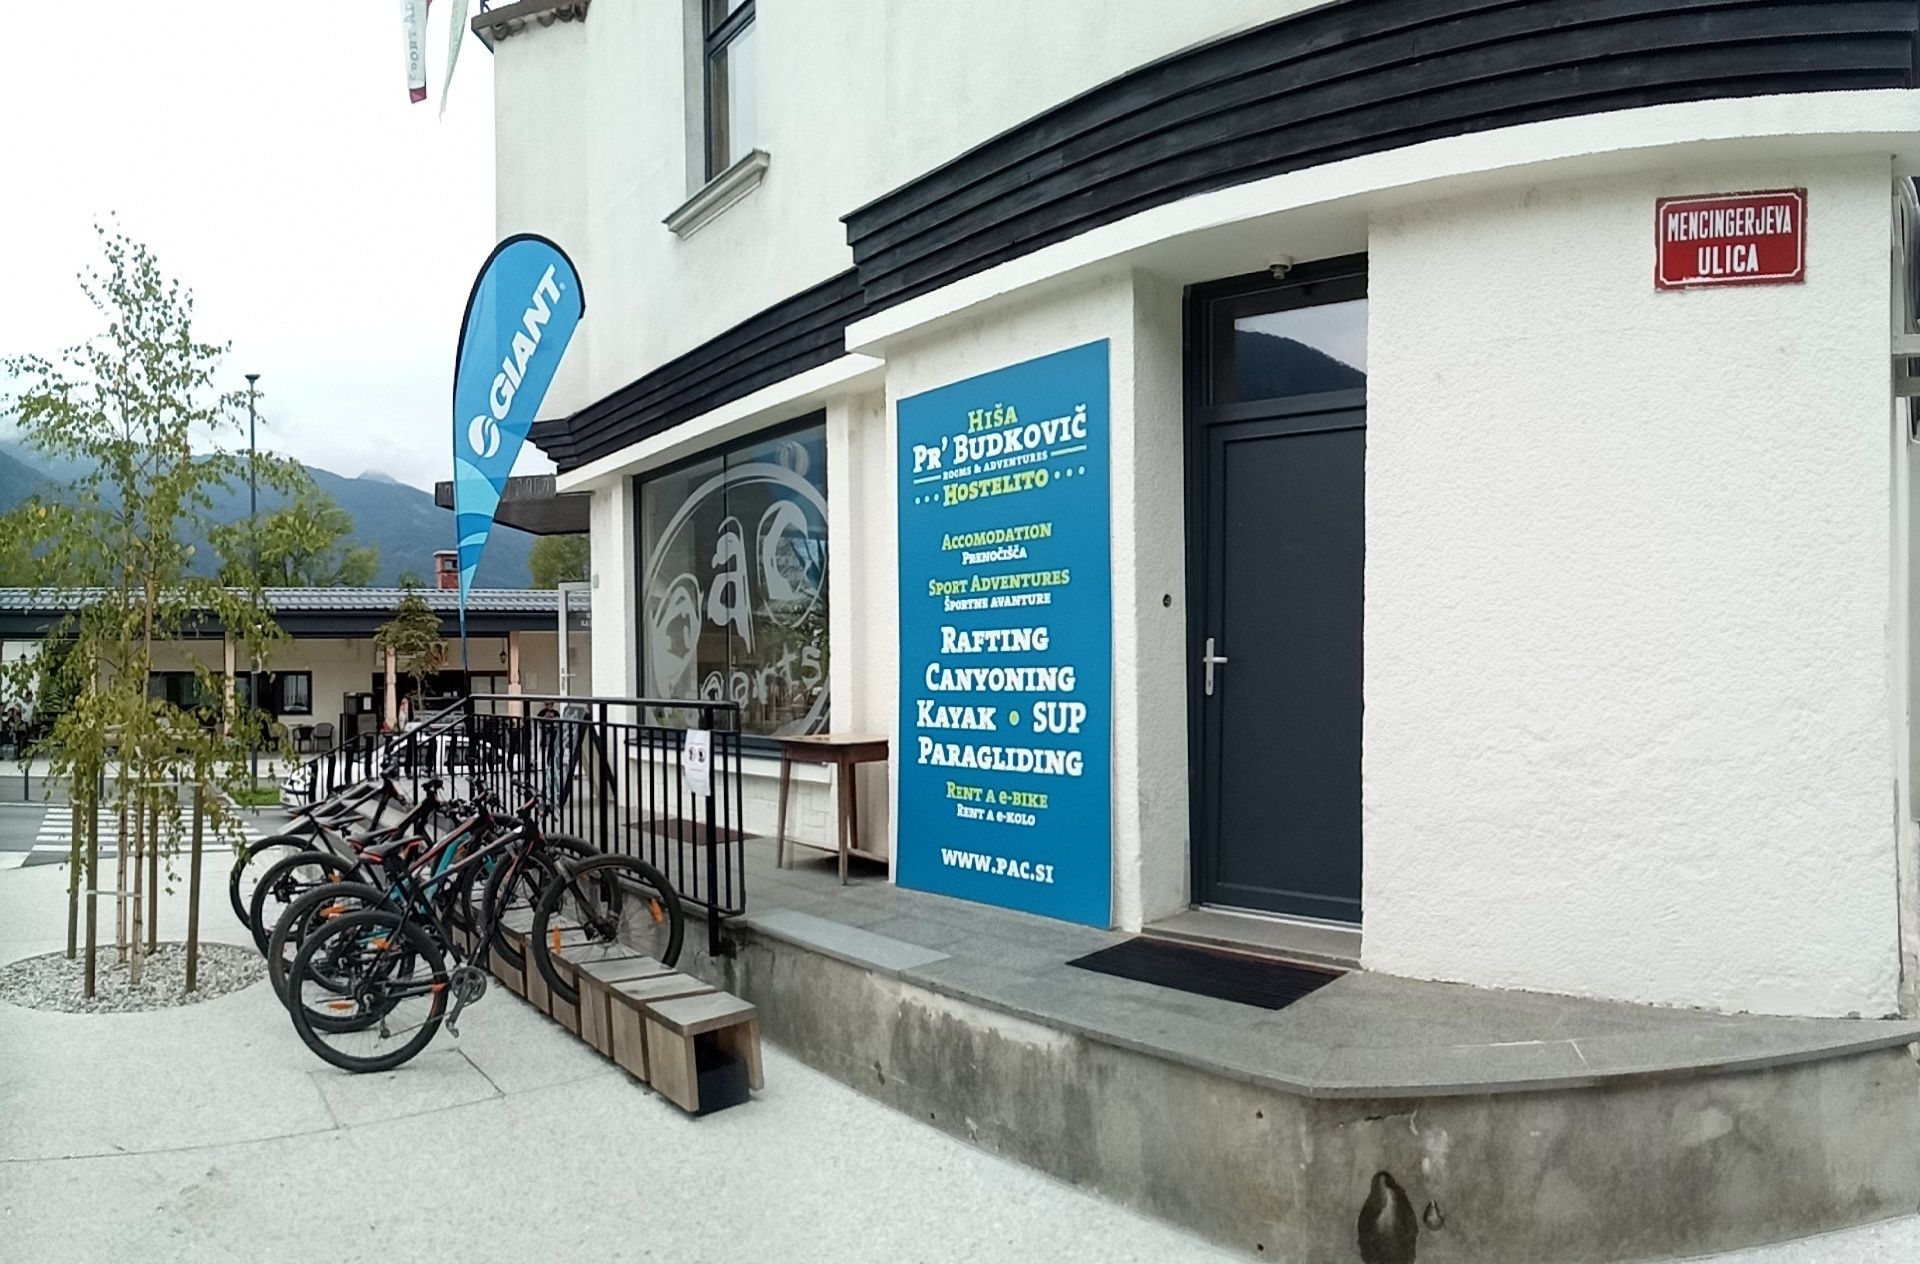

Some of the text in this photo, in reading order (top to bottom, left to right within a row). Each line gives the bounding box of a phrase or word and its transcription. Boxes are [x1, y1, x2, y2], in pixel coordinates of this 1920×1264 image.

[1667, 205, 1792, 242] MENCINGERJEVA
[1698, 243, 1759, 275] ULICA
[489, 263, 561, 420] GIANT
[967, 403, 1018, 433] HIŠA
[952, 403, 1088, 465] BUDKOVIČ
[942, 451, 1049, 480] ROOMS & ADVENTURES
[942, 468, 1049, 507] HOSTELITO
[941, 522, 1053, 551] ACCOMODATION
[961, 544, 1028, 566] PRENOČIŠČA
[928, 569, 1071, 596] SPORT ADVENTURES
[944, 592, 1052, 612] ŠPORTNE AVANTURE
[940, 626, 1050, 654] RAFTING
[925, 662, 1076, 692] CANYONING
[916, 699, 1087, 733] KAYAK SUP
[917, 736, 1084, 777] PARAGLIDING
[946, 781, 1049, 809] RENT A e-BIKE
[956, 803, 985, 820] RENT
[985, 810, 995, 822] A
[940, 848, 1055, 884] WWW.PAC.SI
